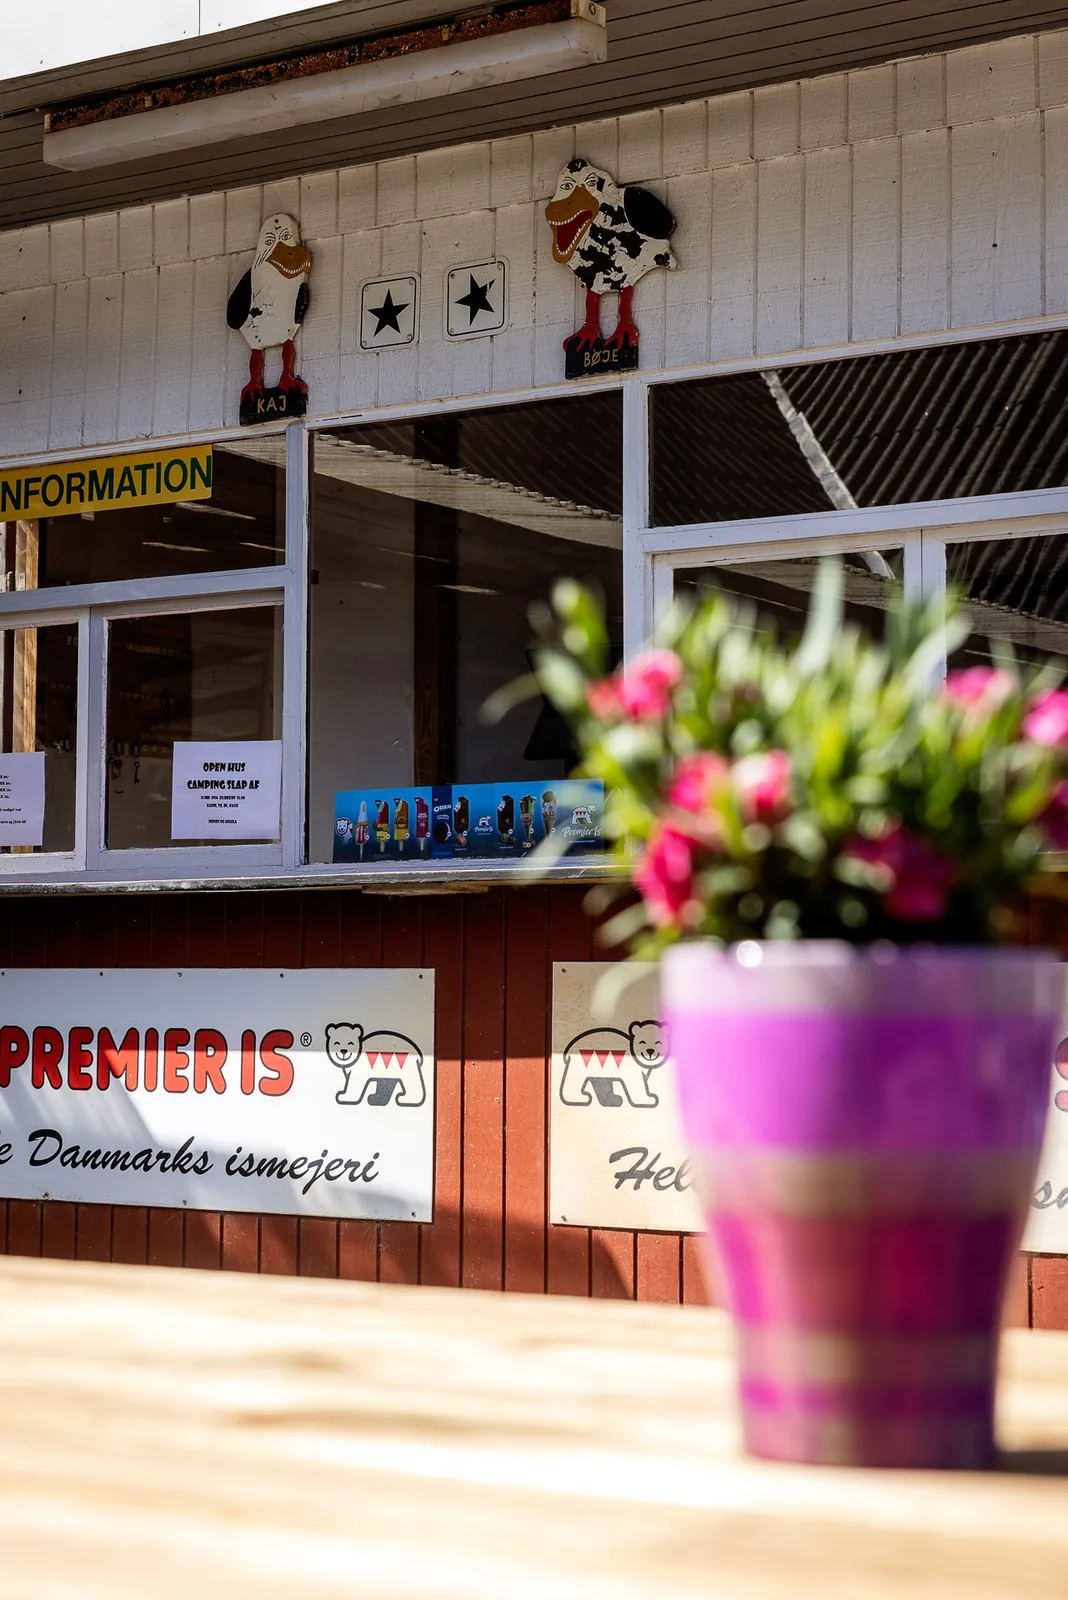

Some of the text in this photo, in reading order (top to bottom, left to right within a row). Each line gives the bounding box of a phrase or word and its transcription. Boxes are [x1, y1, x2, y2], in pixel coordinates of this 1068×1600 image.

[583, 349, 619, 367] BØJE
[257, 395, 287, 414] KAJ
[0, 454, 212, 513] NFORMATION
[203, 762, 246, 772] OPEN HUS
[187, 780, 260, 790] CAMPING SLAP AF
[561, 826, 593, 838] Premier
[0, 1025, 295, 1097] PREMIER IS
[28, 1128, 214, 1175] Danmarks
[225, 1147, 380, 1195] ismejeri
[608, 1146, 694, 1193] Hel
